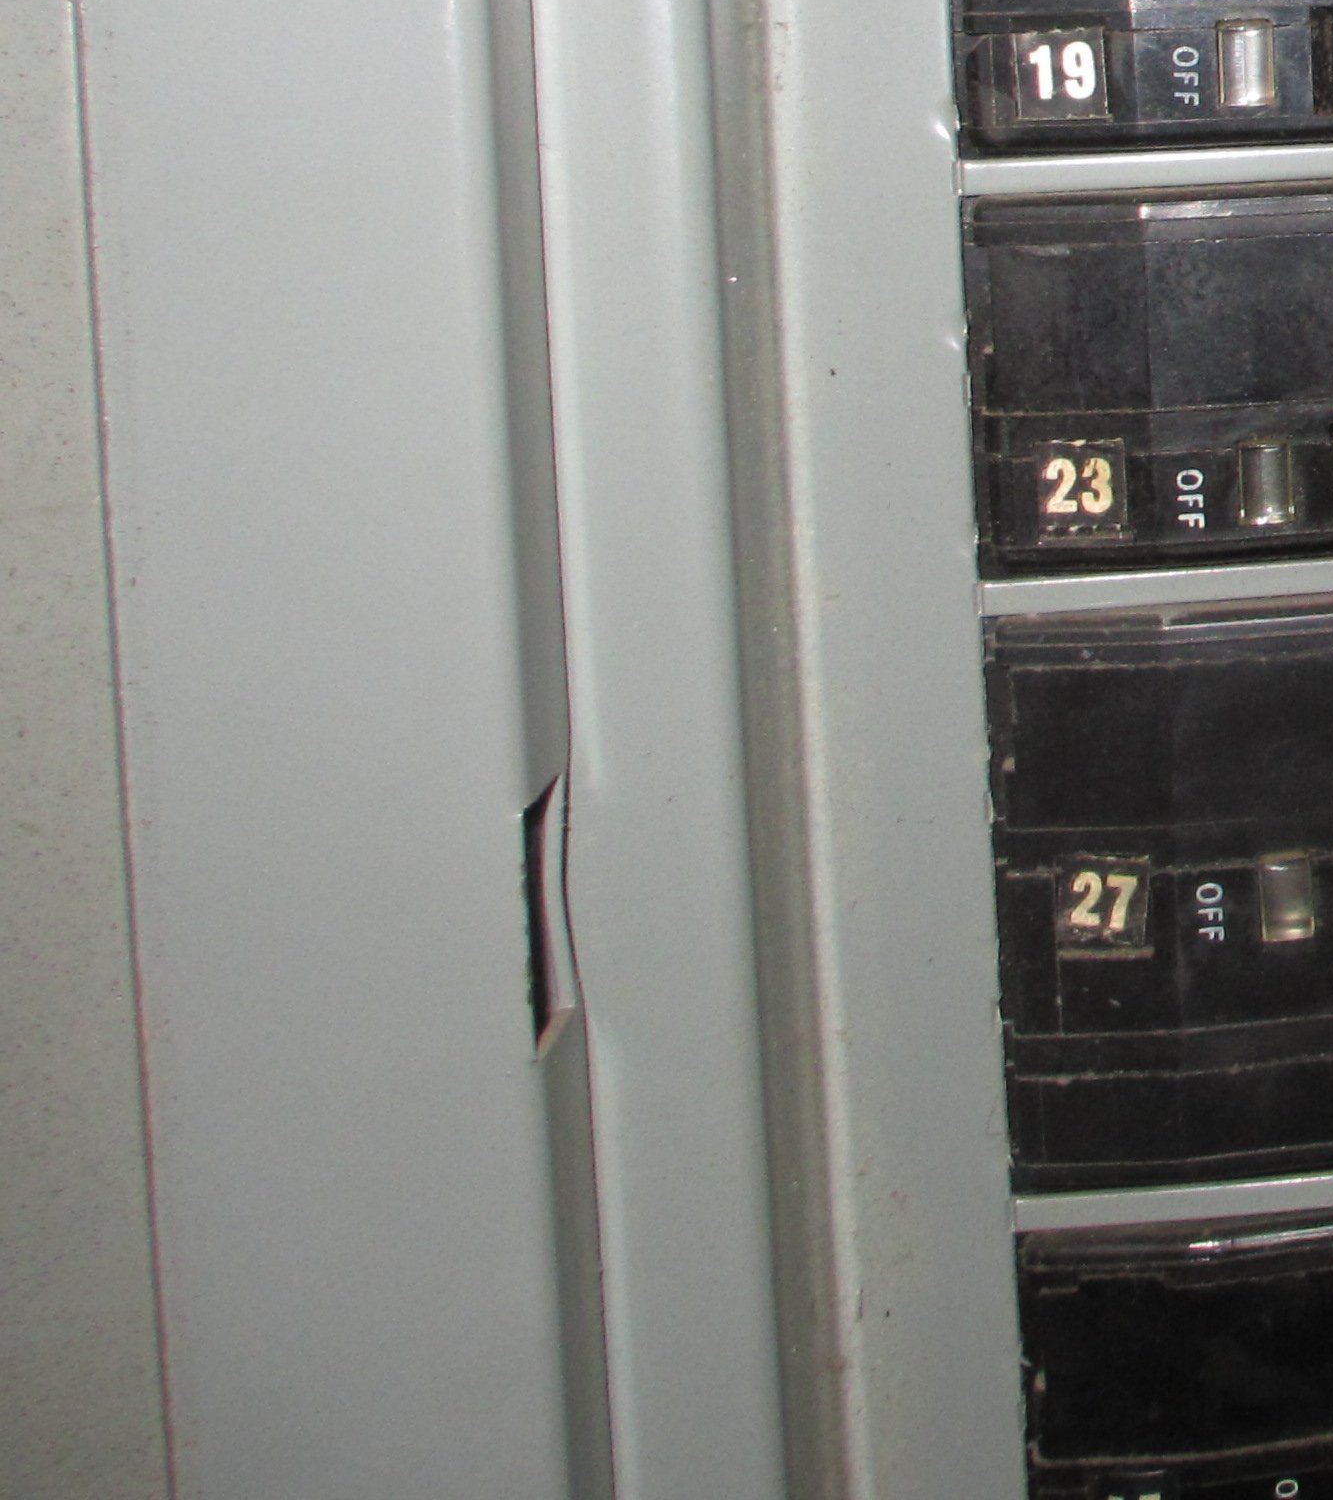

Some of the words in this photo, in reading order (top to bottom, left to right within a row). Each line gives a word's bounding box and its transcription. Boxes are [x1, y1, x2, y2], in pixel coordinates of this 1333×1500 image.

[1028, 40, 1097, 101] 19
[1171, 46, 1200, 107] OFF
[1043, 457, 1113, 514] 23
[1176, 467, 1206, 530] OFF
[1068, 870, 1139, 932] 27
[1195, 882, 1226, 943] OFF
